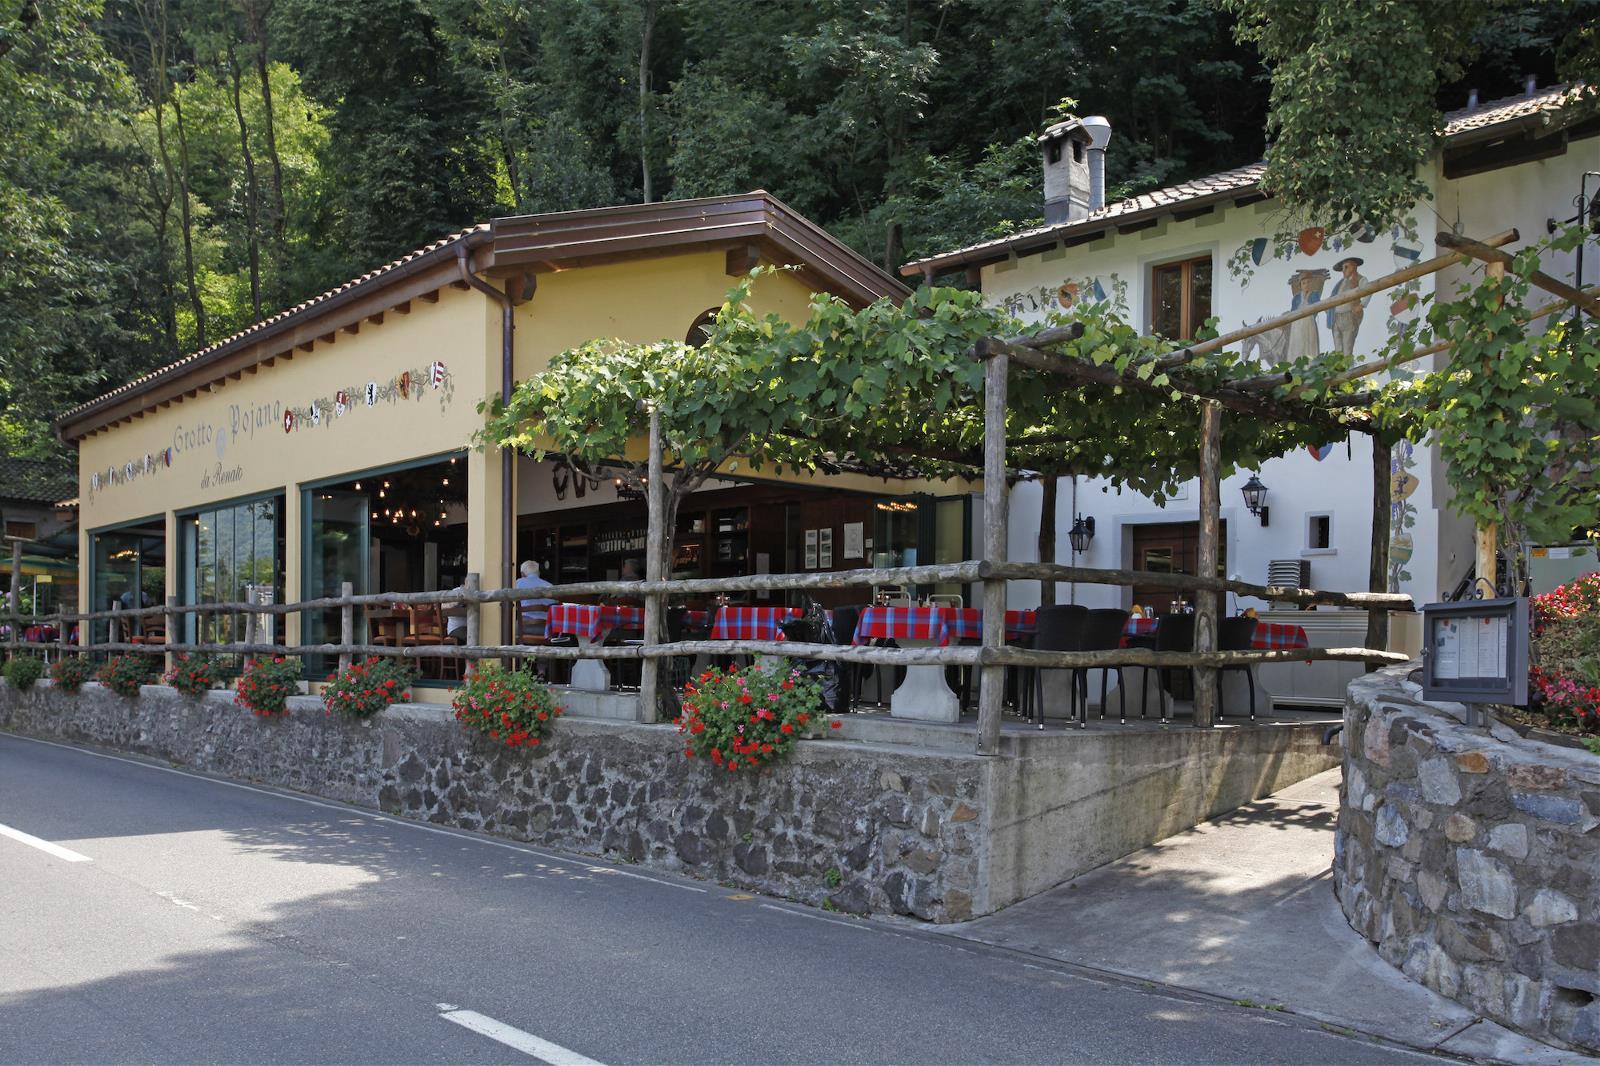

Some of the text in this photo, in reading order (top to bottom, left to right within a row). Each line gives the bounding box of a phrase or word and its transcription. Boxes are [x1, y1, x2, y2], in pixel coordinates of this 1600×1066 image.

[173, 400, 280, 454] Grotto Pojana
[200, 461, 244, 489] da Renato
